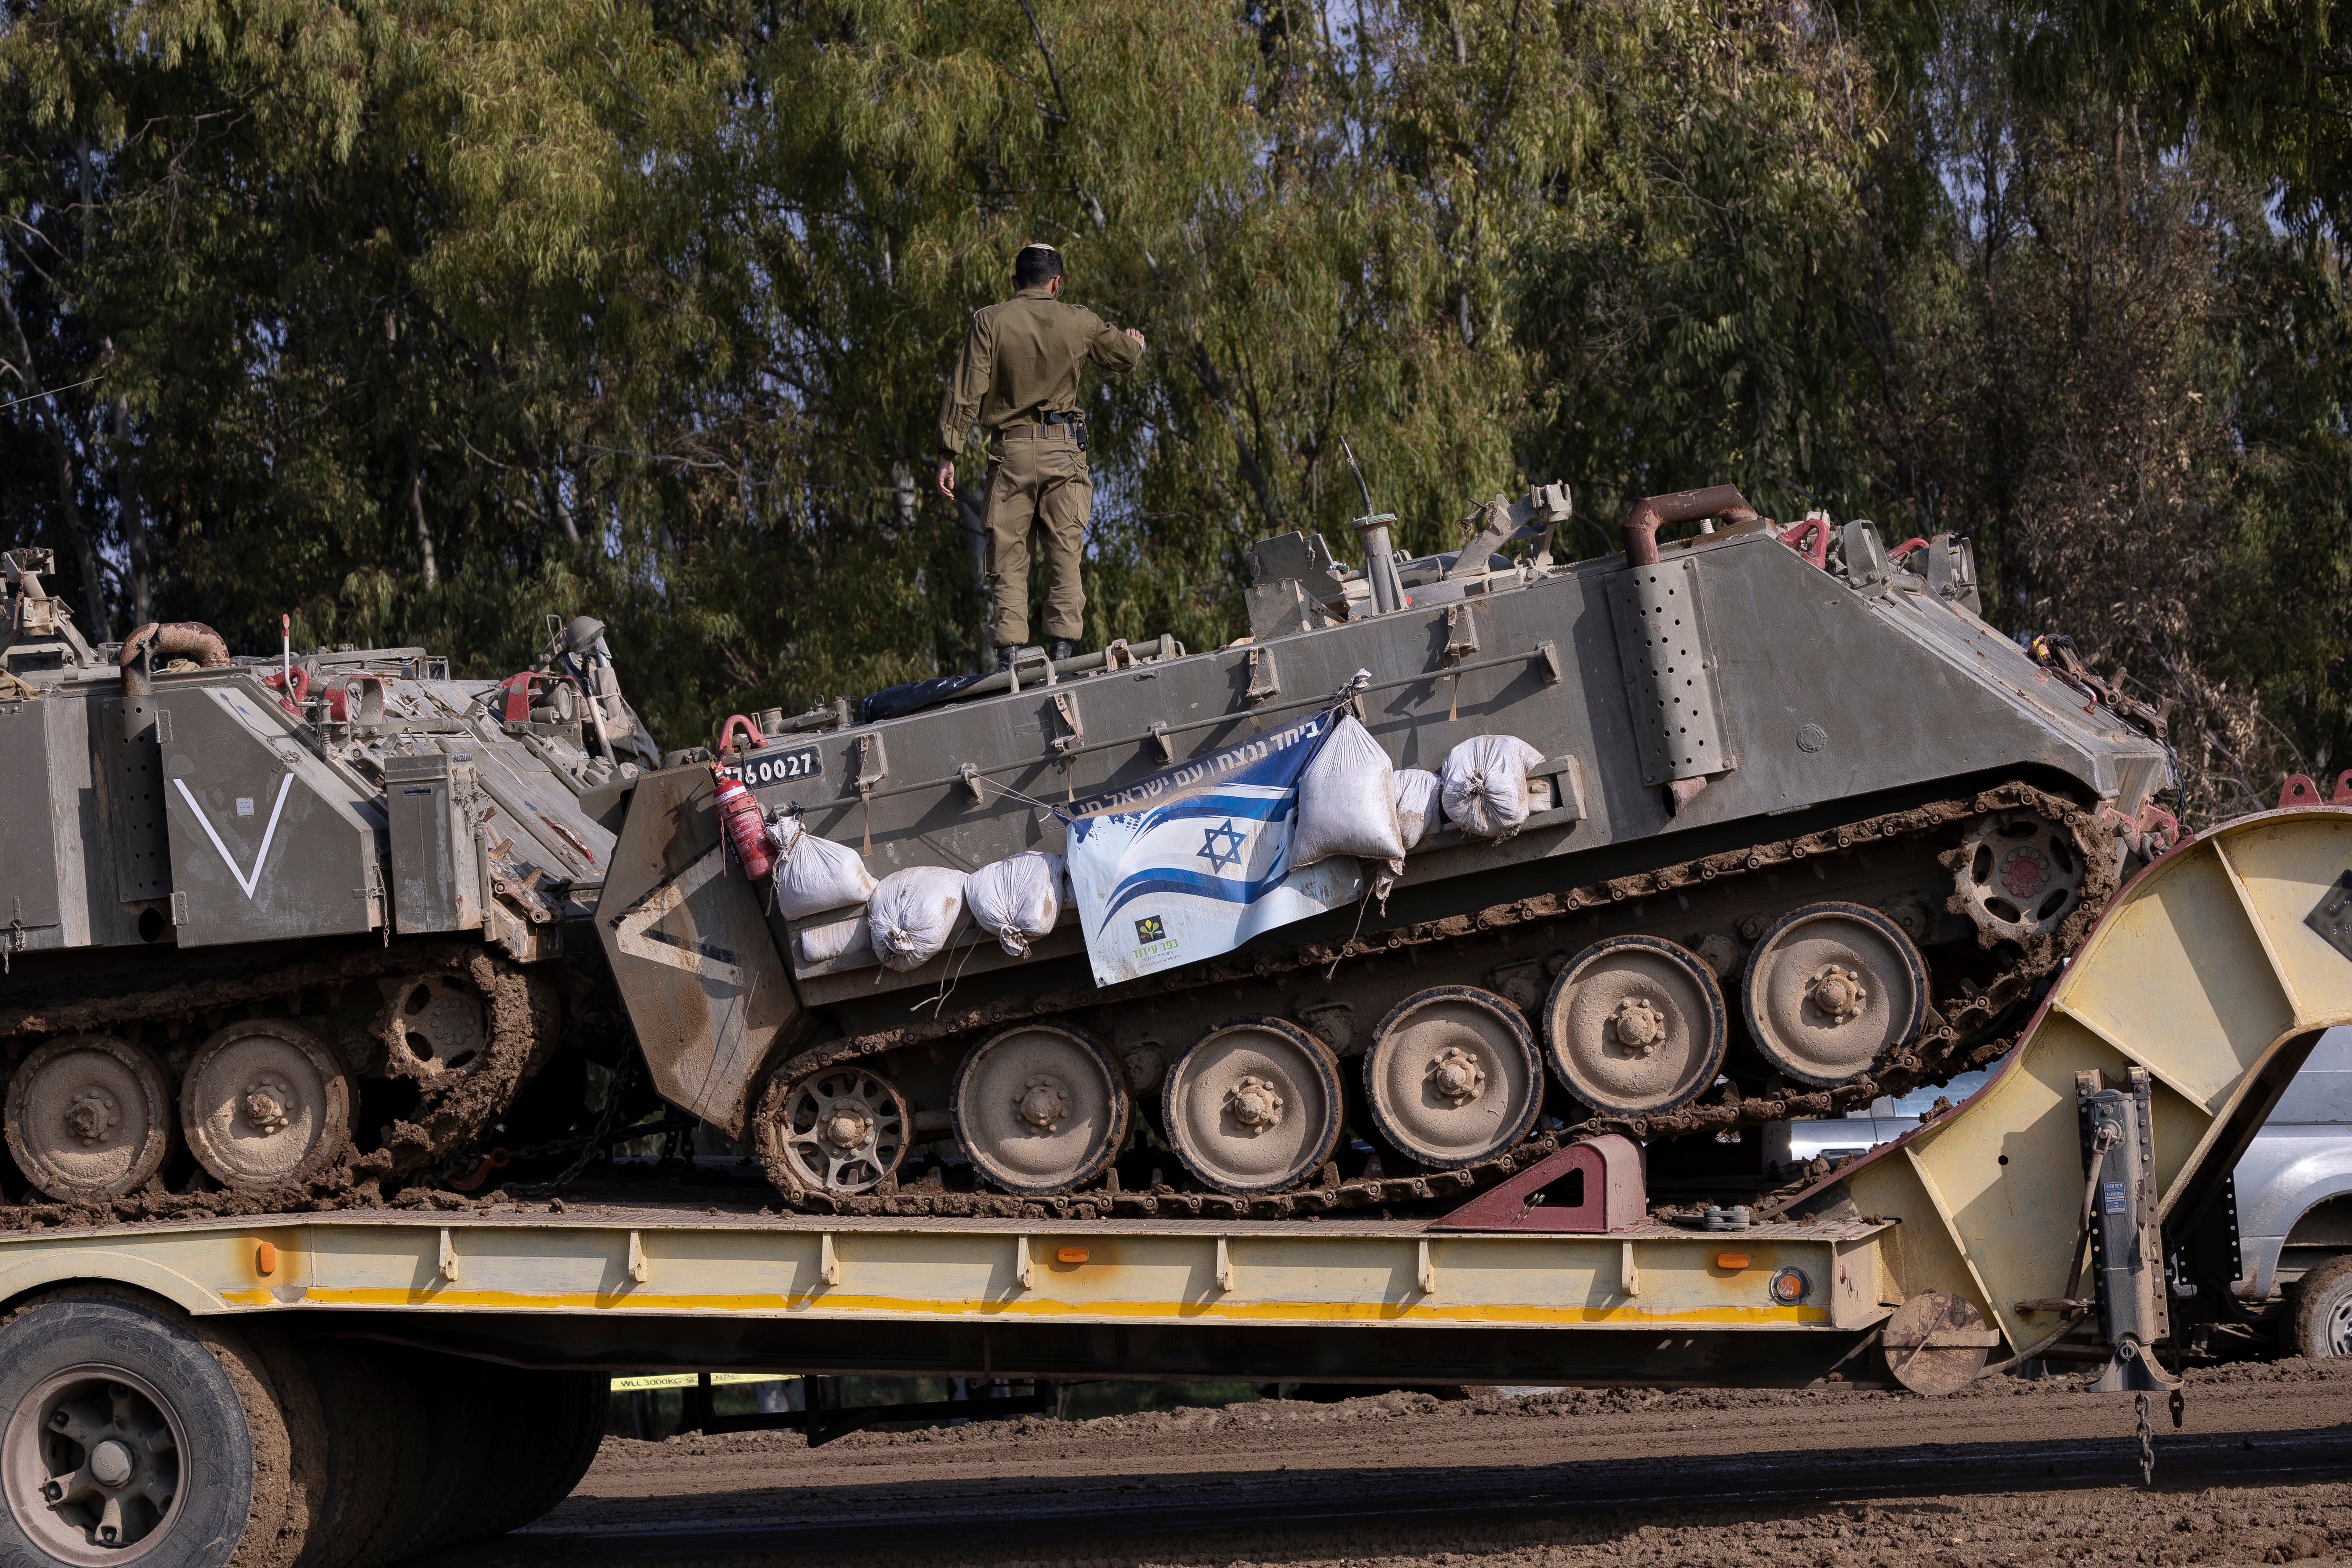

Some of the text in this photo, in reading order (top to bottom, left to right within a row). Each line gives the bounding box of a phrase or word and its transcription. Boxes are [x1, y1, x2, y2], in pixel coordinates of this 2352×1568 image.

[1270, 720, 1321, 751] ביחד
[732, 754, 811, 784] 760027
[1216, 740, 1269, 772] ננצח
[1173, 764, 1203, 788] עם
[1103, 778, 1170, 807] ישראל
[1132, 939, 1178, 959] כפר עידוד
[190, 1406, 220, 1489] MSA
